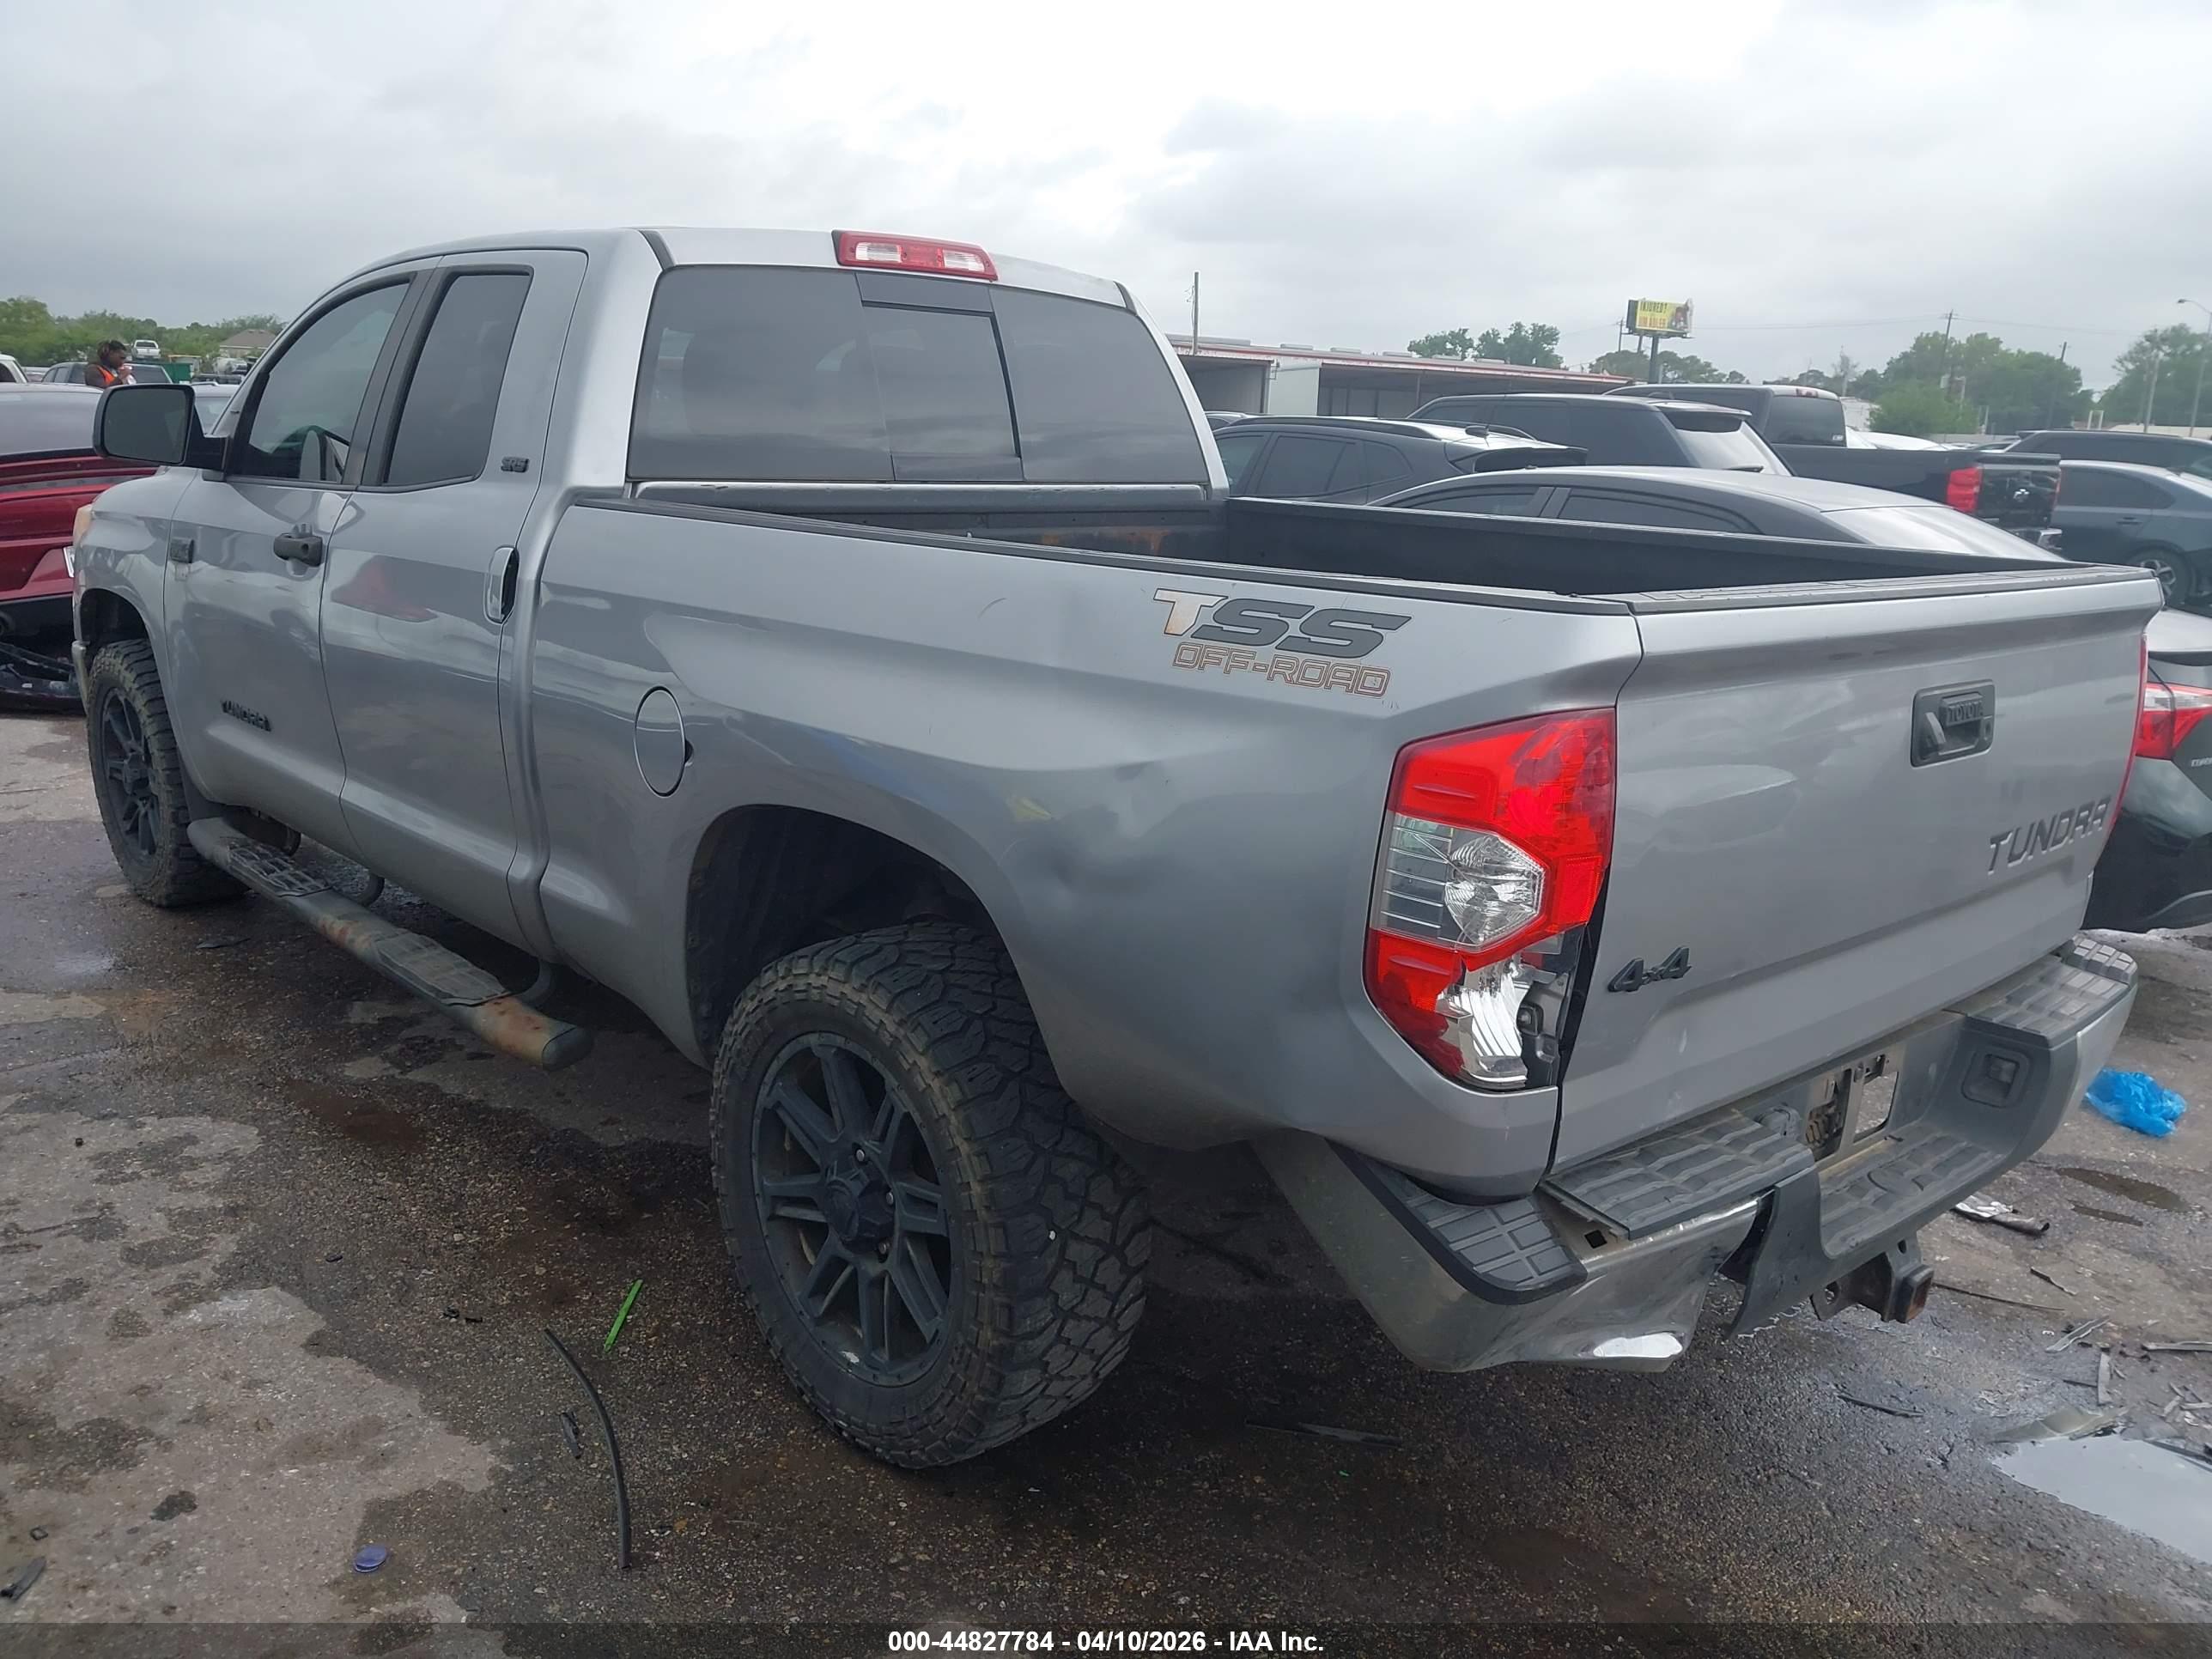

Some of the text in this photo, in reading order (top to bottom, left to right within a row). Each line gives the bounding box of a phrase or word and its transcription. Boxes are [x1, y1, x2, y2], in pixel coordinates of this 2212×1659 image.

[1153, 588, 1412, 659] TSS
[1172, 642, 1391, 698] OFF-ROAD
[1987, 794, 2112, 876] TUNDRA
